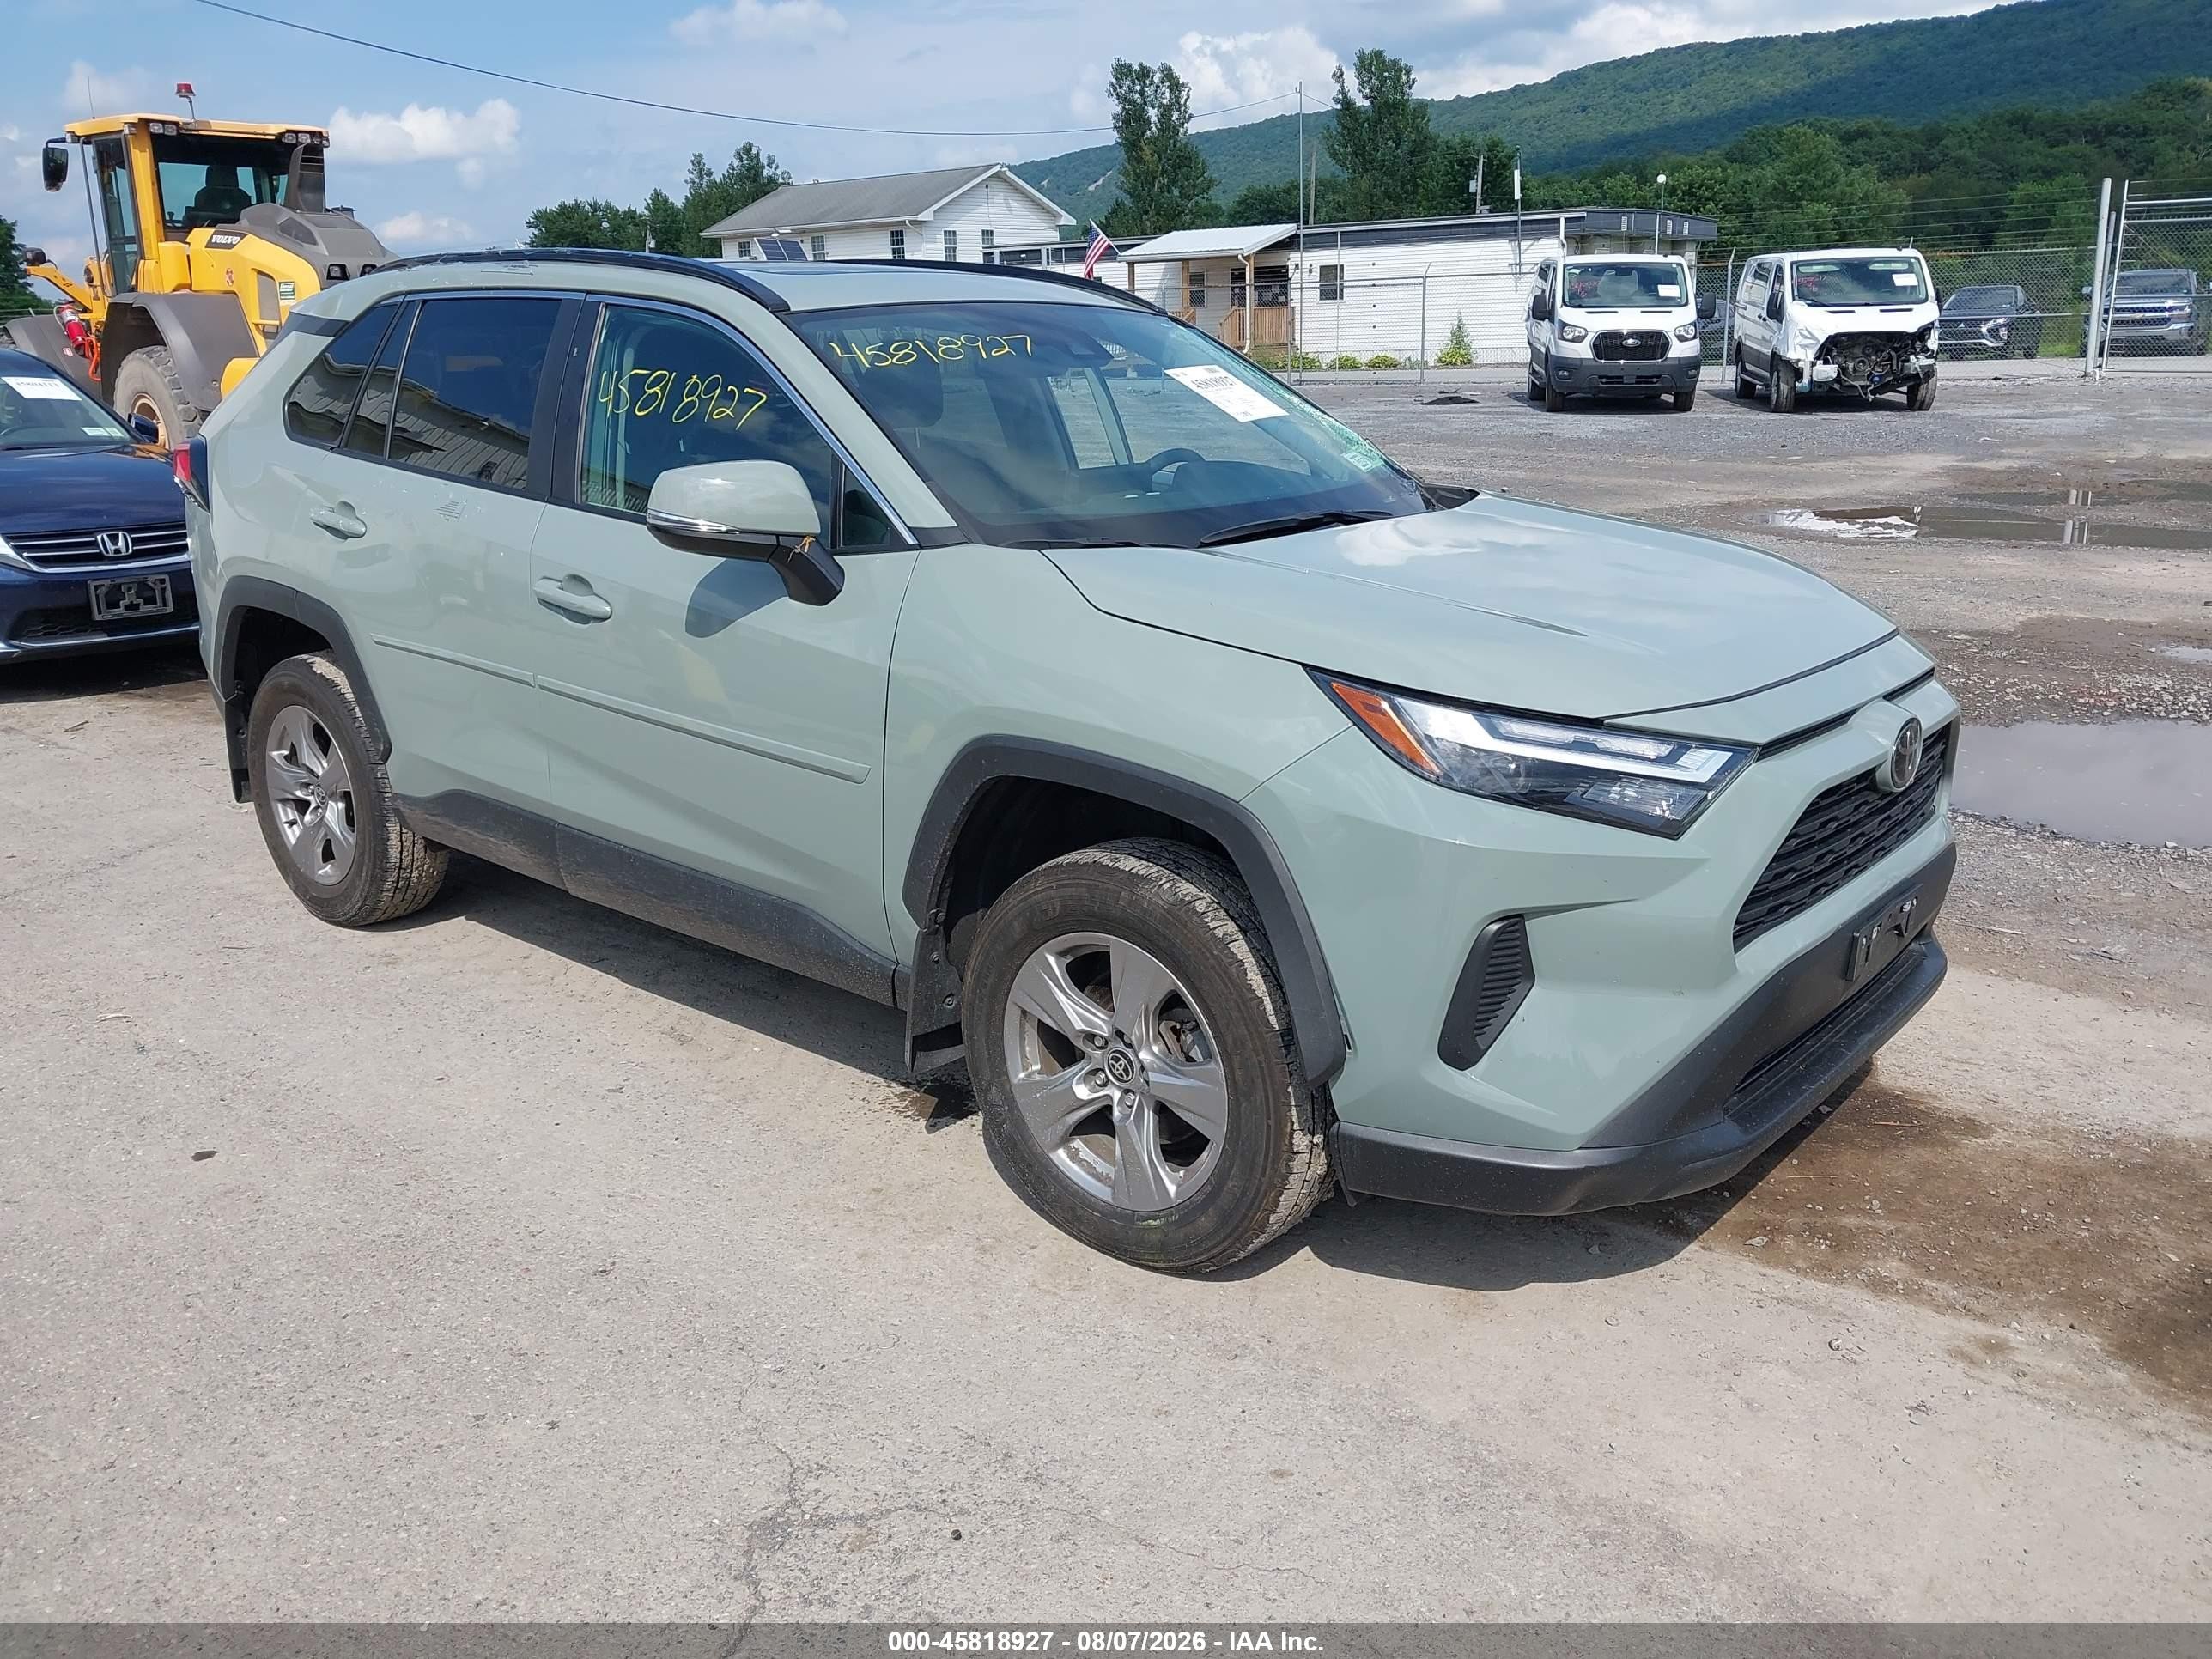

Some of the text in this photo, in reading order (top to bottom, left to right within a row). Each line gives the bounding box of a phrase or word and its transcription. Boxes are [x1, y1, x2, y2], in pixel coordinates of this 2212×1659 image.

[210, 234, 241, 245] VOLVO
[829, 334, 1032, 368] 45818927
[598, 370, 768, 431] 45818927
